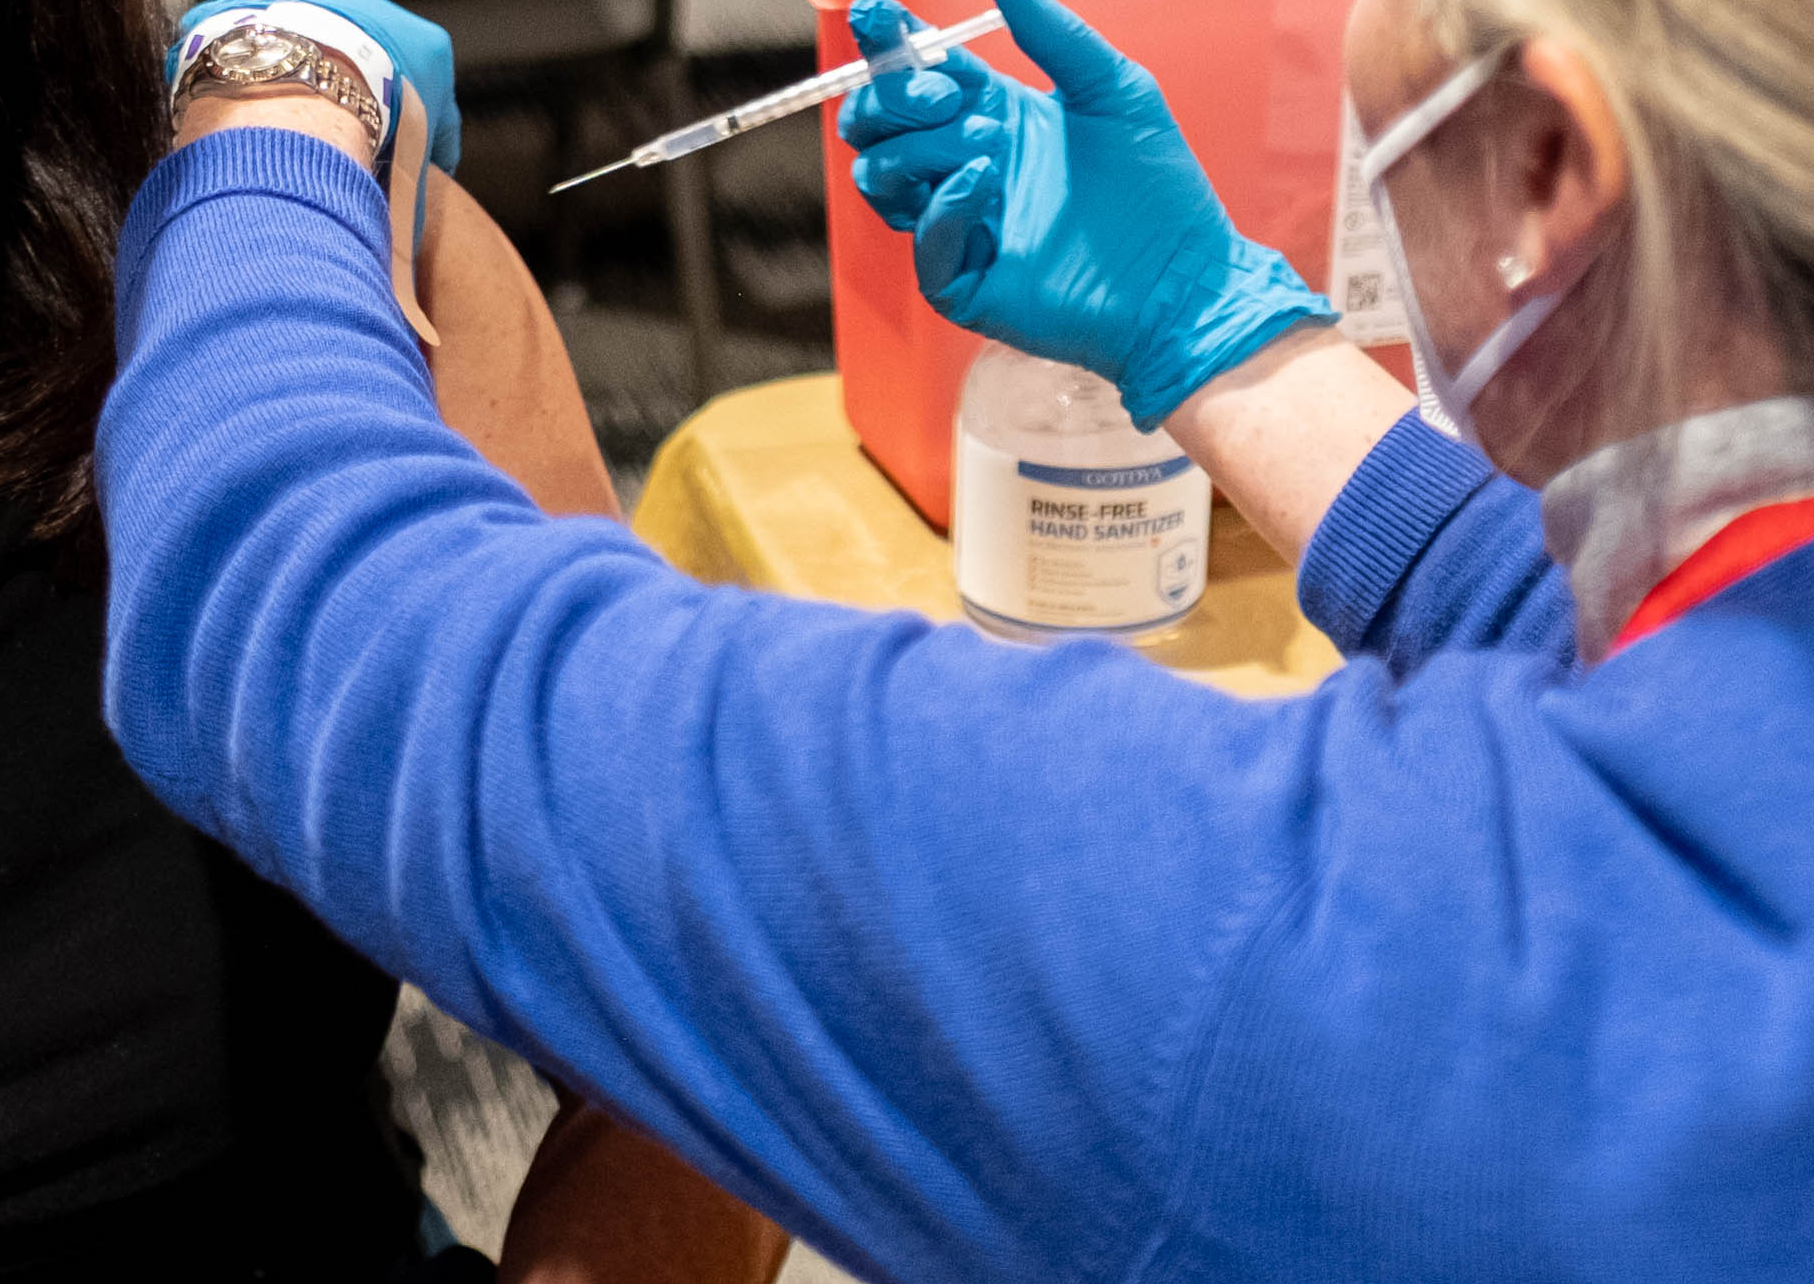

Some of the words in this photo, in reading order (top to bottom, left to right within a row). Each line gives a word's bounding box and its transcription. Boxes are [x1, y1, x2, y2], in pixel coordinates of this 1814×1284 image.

[1030, 498, 1149, 520] RINSE-FREE
[1028, 519, 1089, 541] HAND
[1093, 510, 1185, 542] SANITIZER
